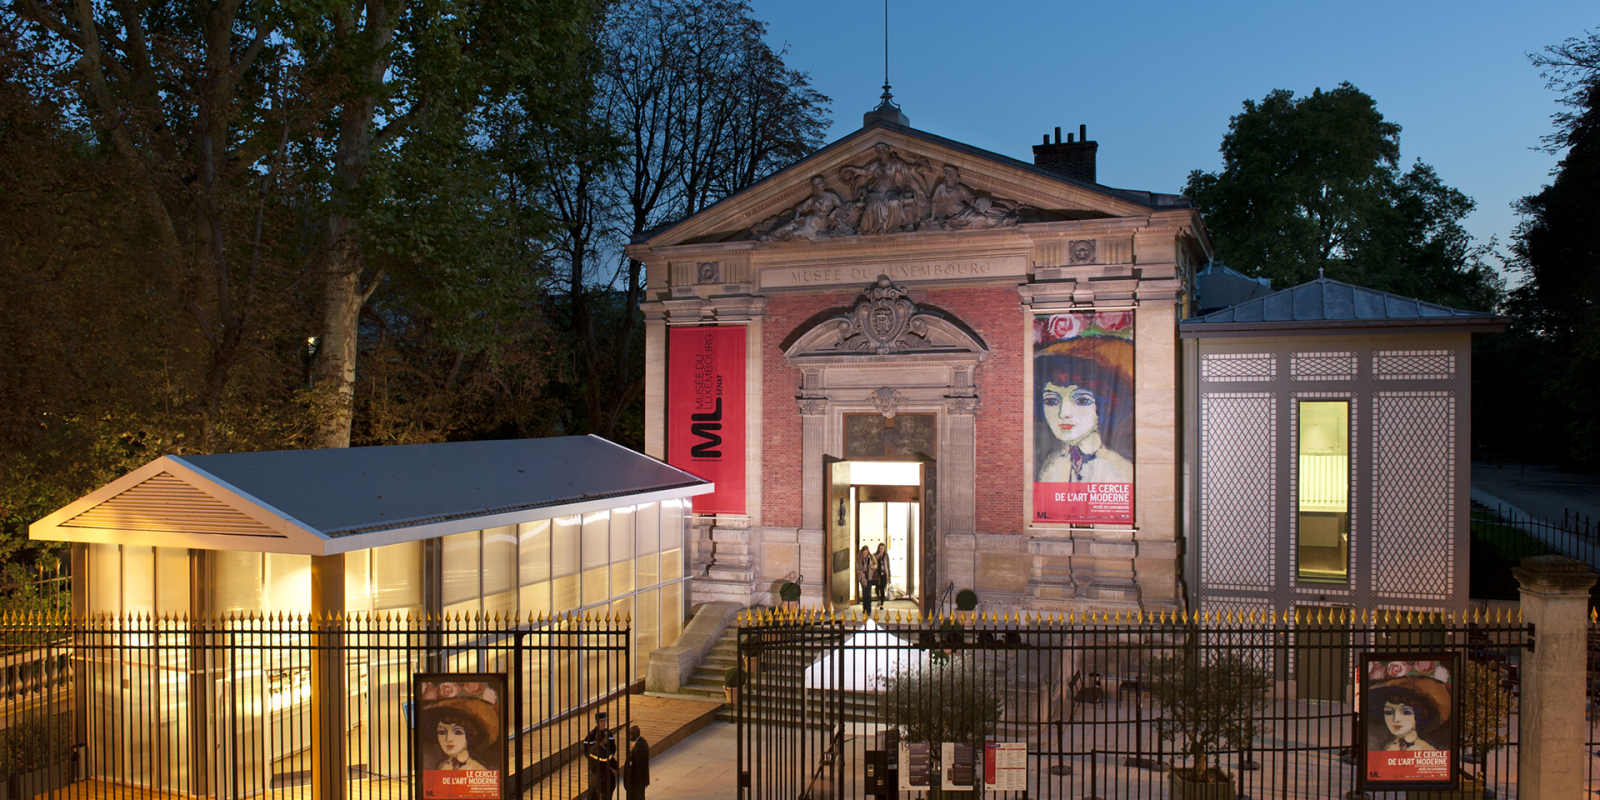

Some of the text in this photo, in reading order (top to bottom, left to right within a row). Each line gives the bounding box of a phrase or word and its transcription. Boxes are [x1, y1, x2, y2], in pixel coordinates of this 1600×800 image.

[851, 267, 871, 279] DU
[882, 261, 991, 278] LUXEMBOURG
[704, 334, 713, 410] LUXEMBOURG
[694, 354, 704, 410] MUSÉE DU
[691, 396, 722, 458] ML
[1055, 493, 1129, 502] DE L'ART MODERNE
[1087, 484, 1129, 493] LE CERCLE
[823, 753, 832, 761] 19
